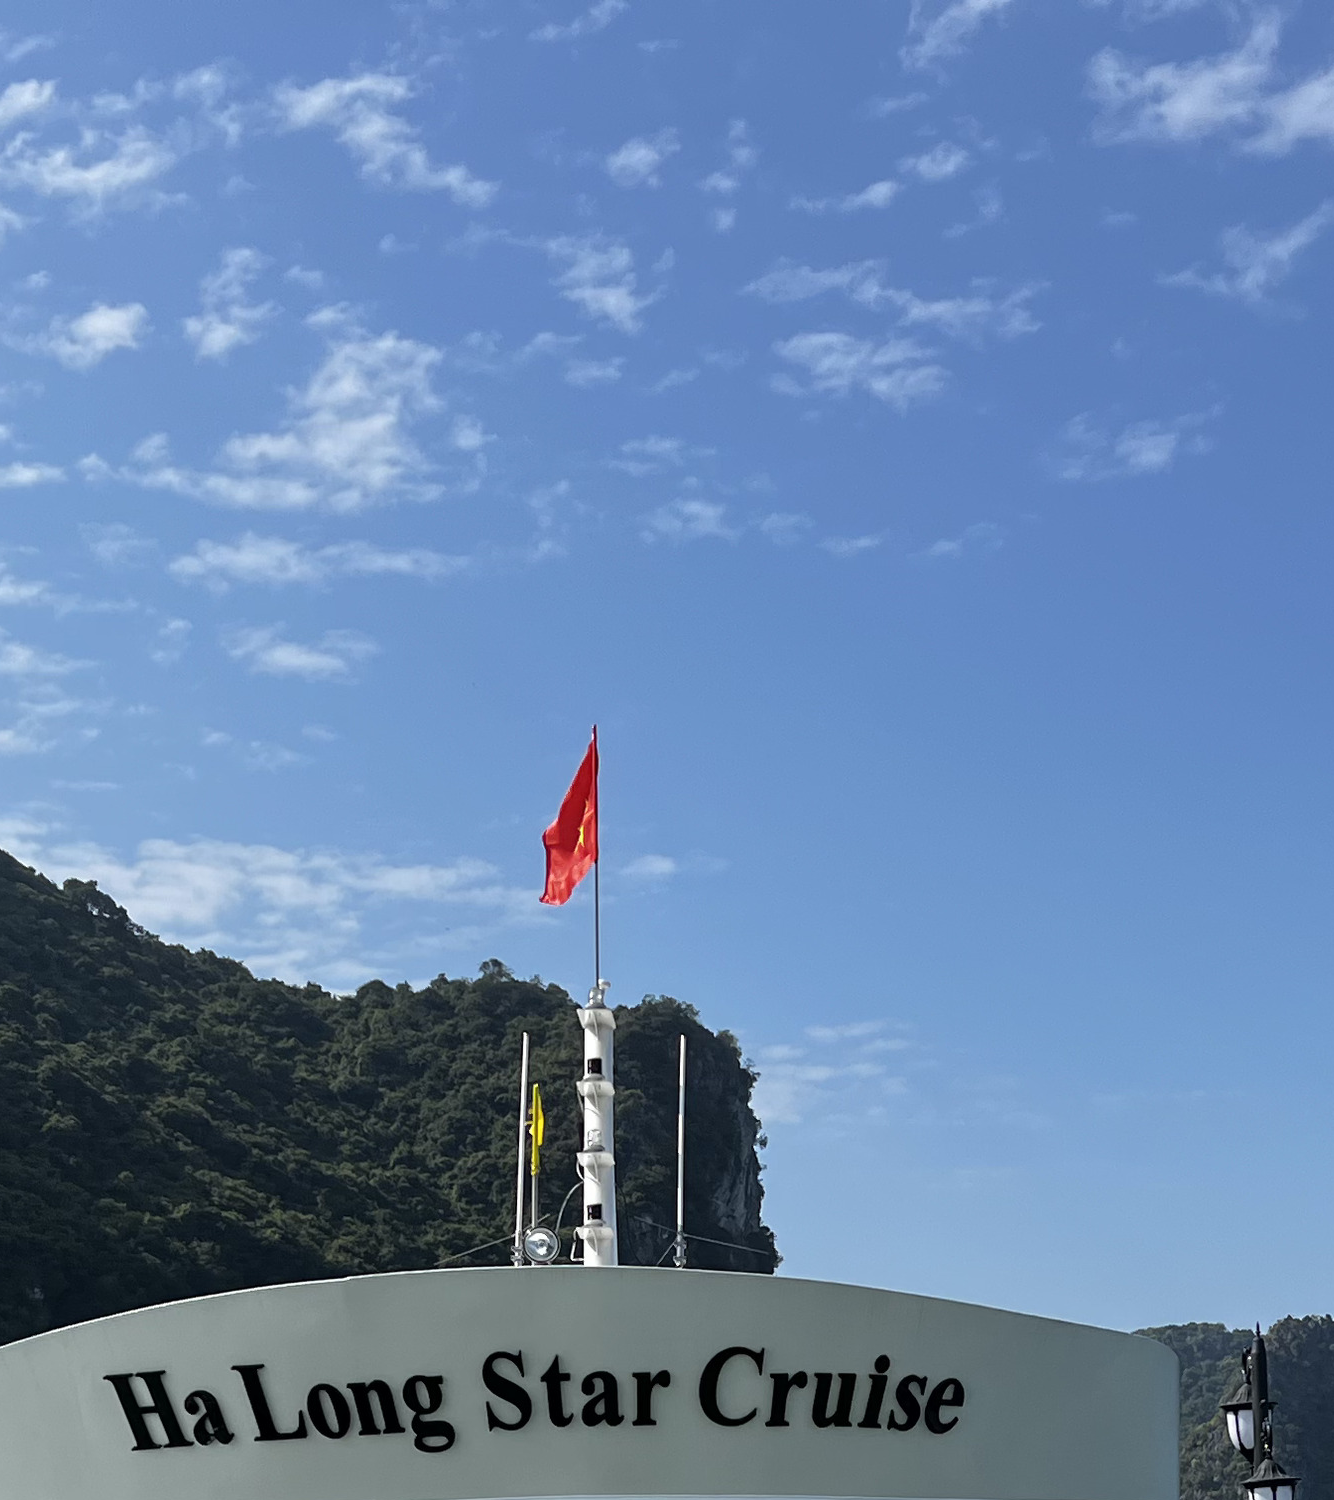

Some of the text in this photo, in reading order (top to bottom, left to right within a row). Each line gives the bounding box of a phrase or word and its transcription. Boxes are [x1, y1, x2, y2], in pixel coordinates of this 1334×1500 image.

[102, 1345, 966, 1454] Ha Long Star Cruise
